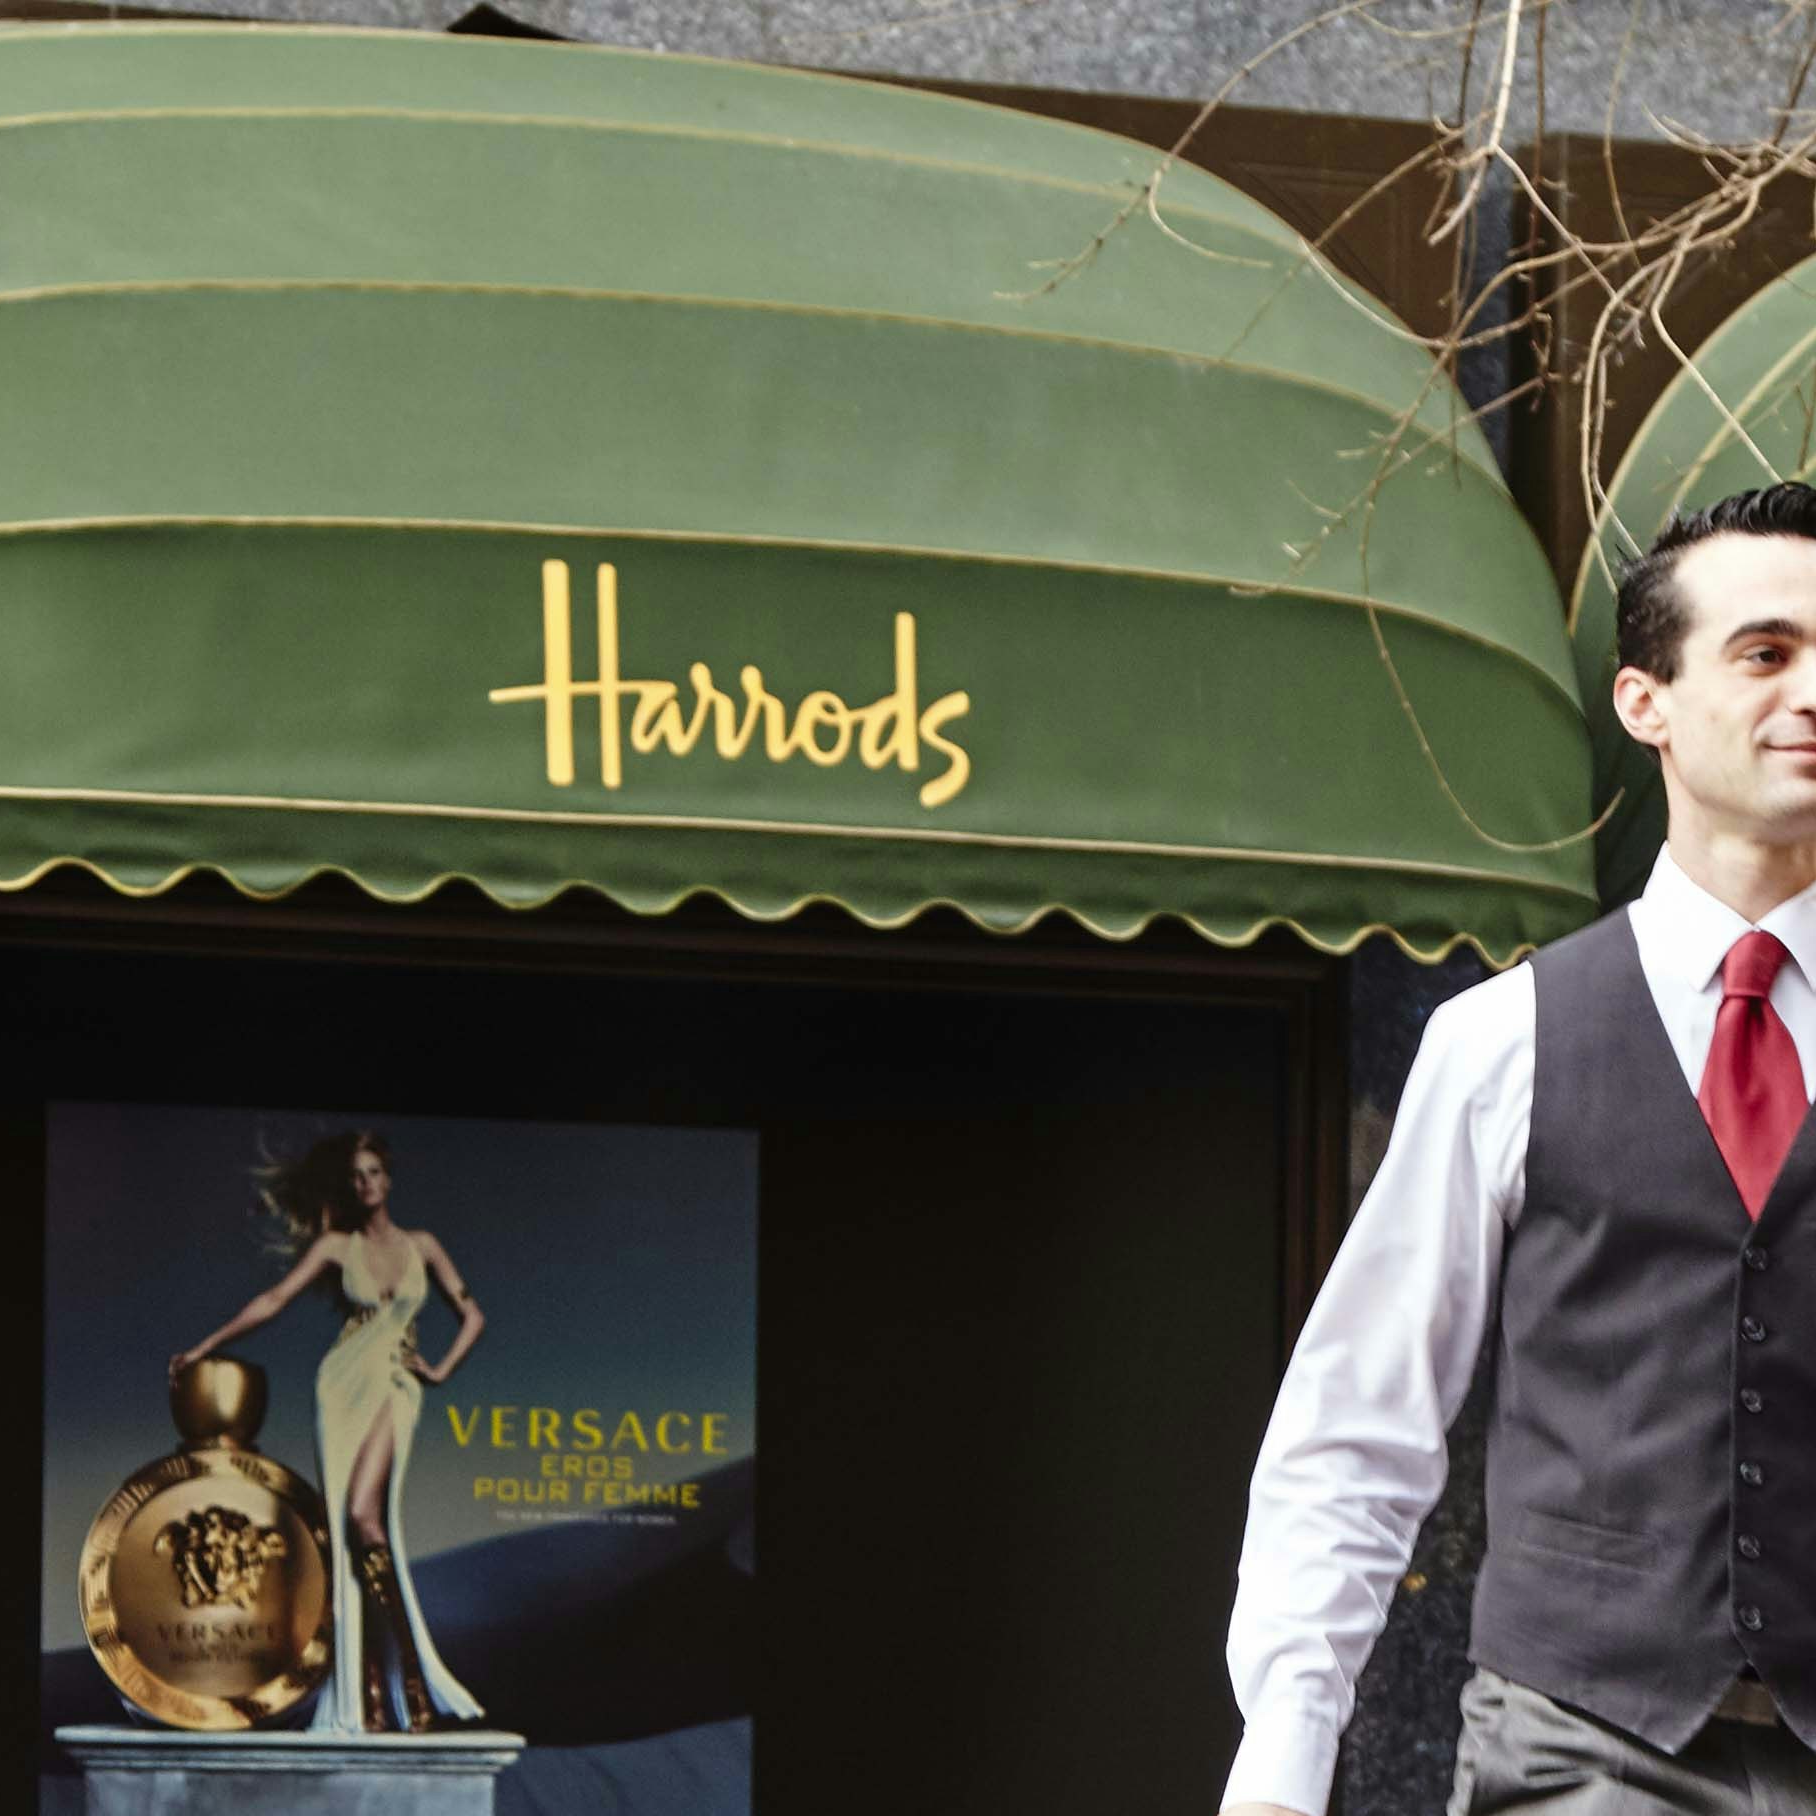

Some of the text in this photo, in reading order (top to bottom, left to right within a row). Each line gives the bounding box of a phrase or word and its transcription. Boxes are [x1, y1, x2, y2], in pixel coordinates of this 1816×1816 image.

[488, 558, 971, 808] Harrods
[446, 1405, 731, 1455] VERSACE
[541, 1454, 634, 1480] EROS
[473, 1477, 700, 1508] POUR FEMME
